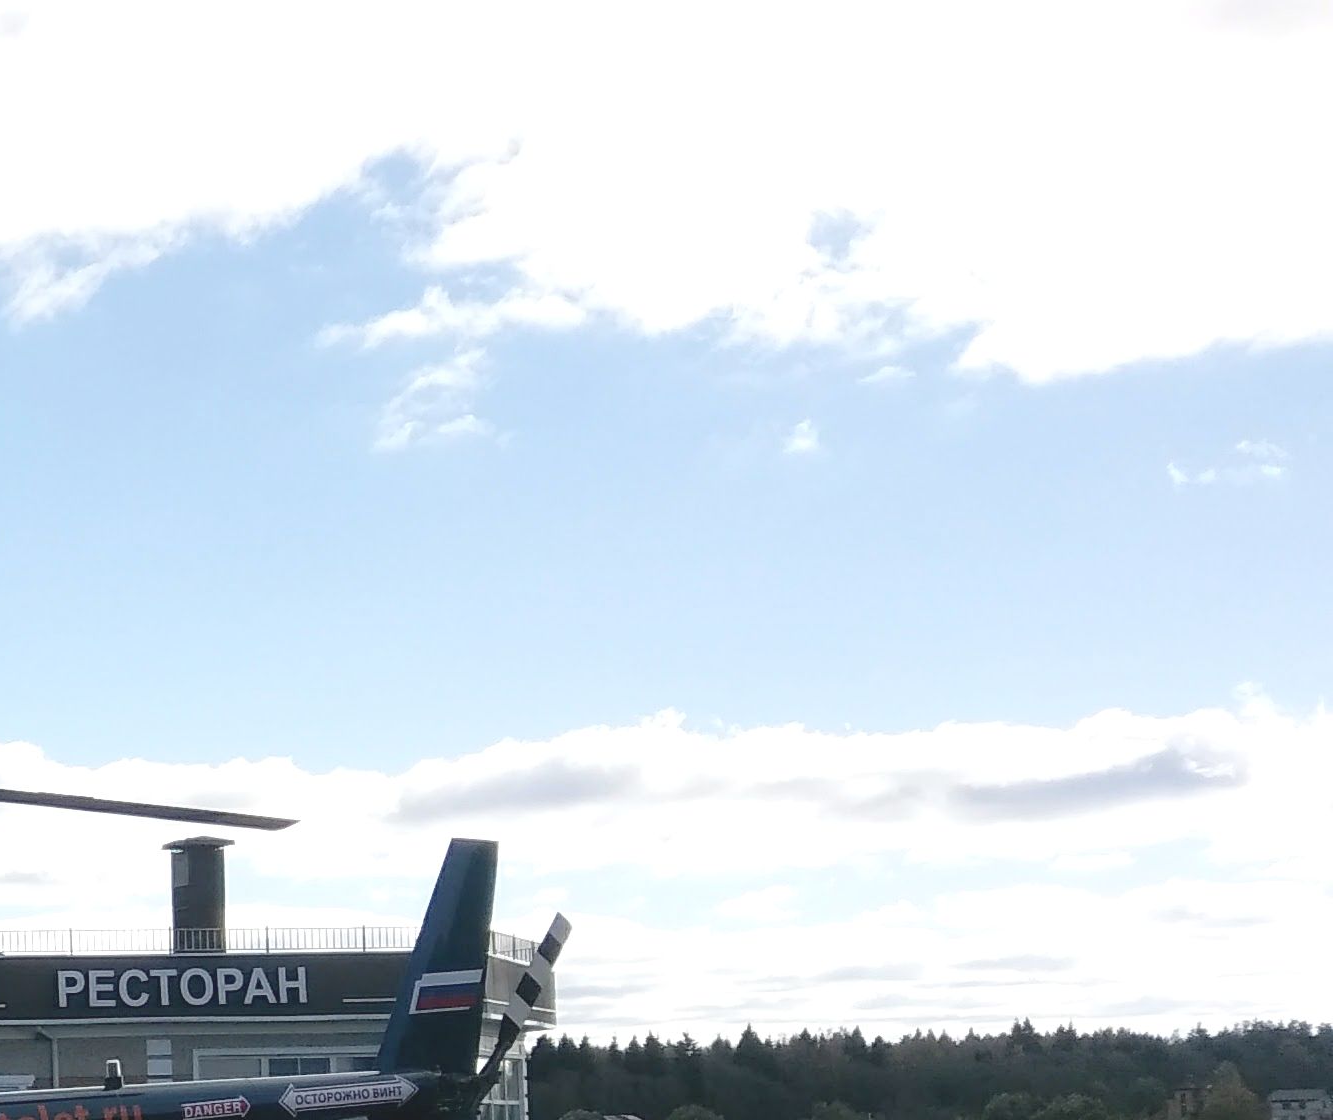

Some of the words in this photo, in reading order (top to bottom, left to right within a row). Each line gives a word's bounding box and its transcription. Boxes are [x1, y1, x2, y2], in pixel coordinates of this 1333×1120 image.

[56, 966, 309, 1008] РЕСТОРАН
[295, 1088, 369, 1106] ОСТОРОЖНО
[372, 1086, 402, 1098] ВИНТ
[184, 1102, 243, 1118] DANGER
